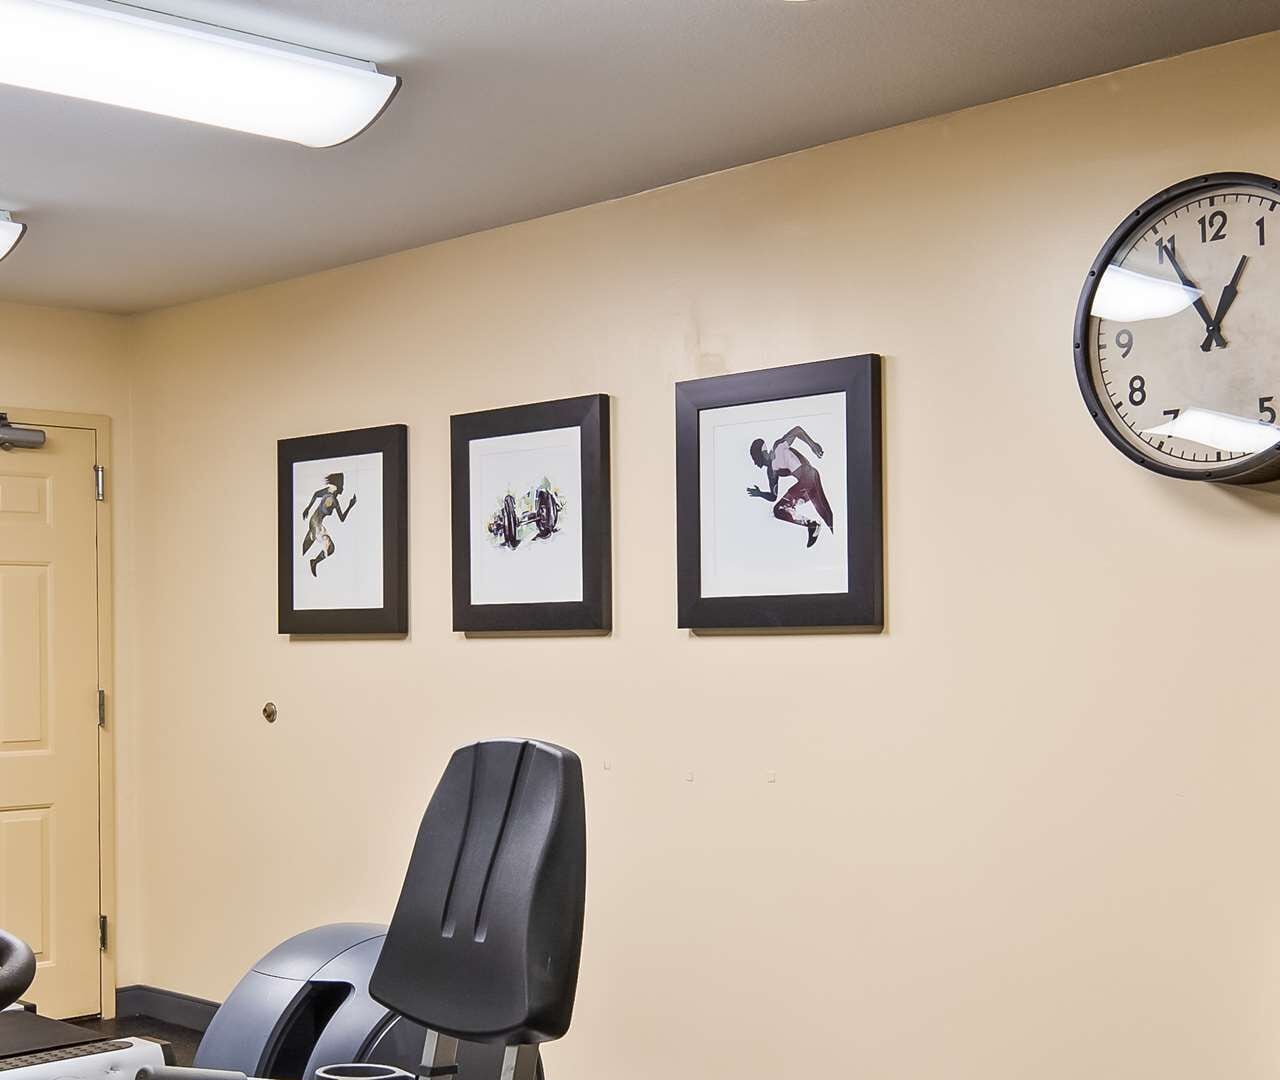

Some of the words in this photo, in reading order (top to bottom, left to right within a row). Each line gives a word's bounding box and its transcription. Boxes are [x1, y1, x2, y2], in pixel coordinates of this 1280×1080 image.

[1197, 211, 1228, 243] 12
[1255, 217, 1265, 246] 1
[1115, 329, 1134, 359] 9
[1128, 375, 1147, 406] 8
[1258, 397, 1276, 425] 5
